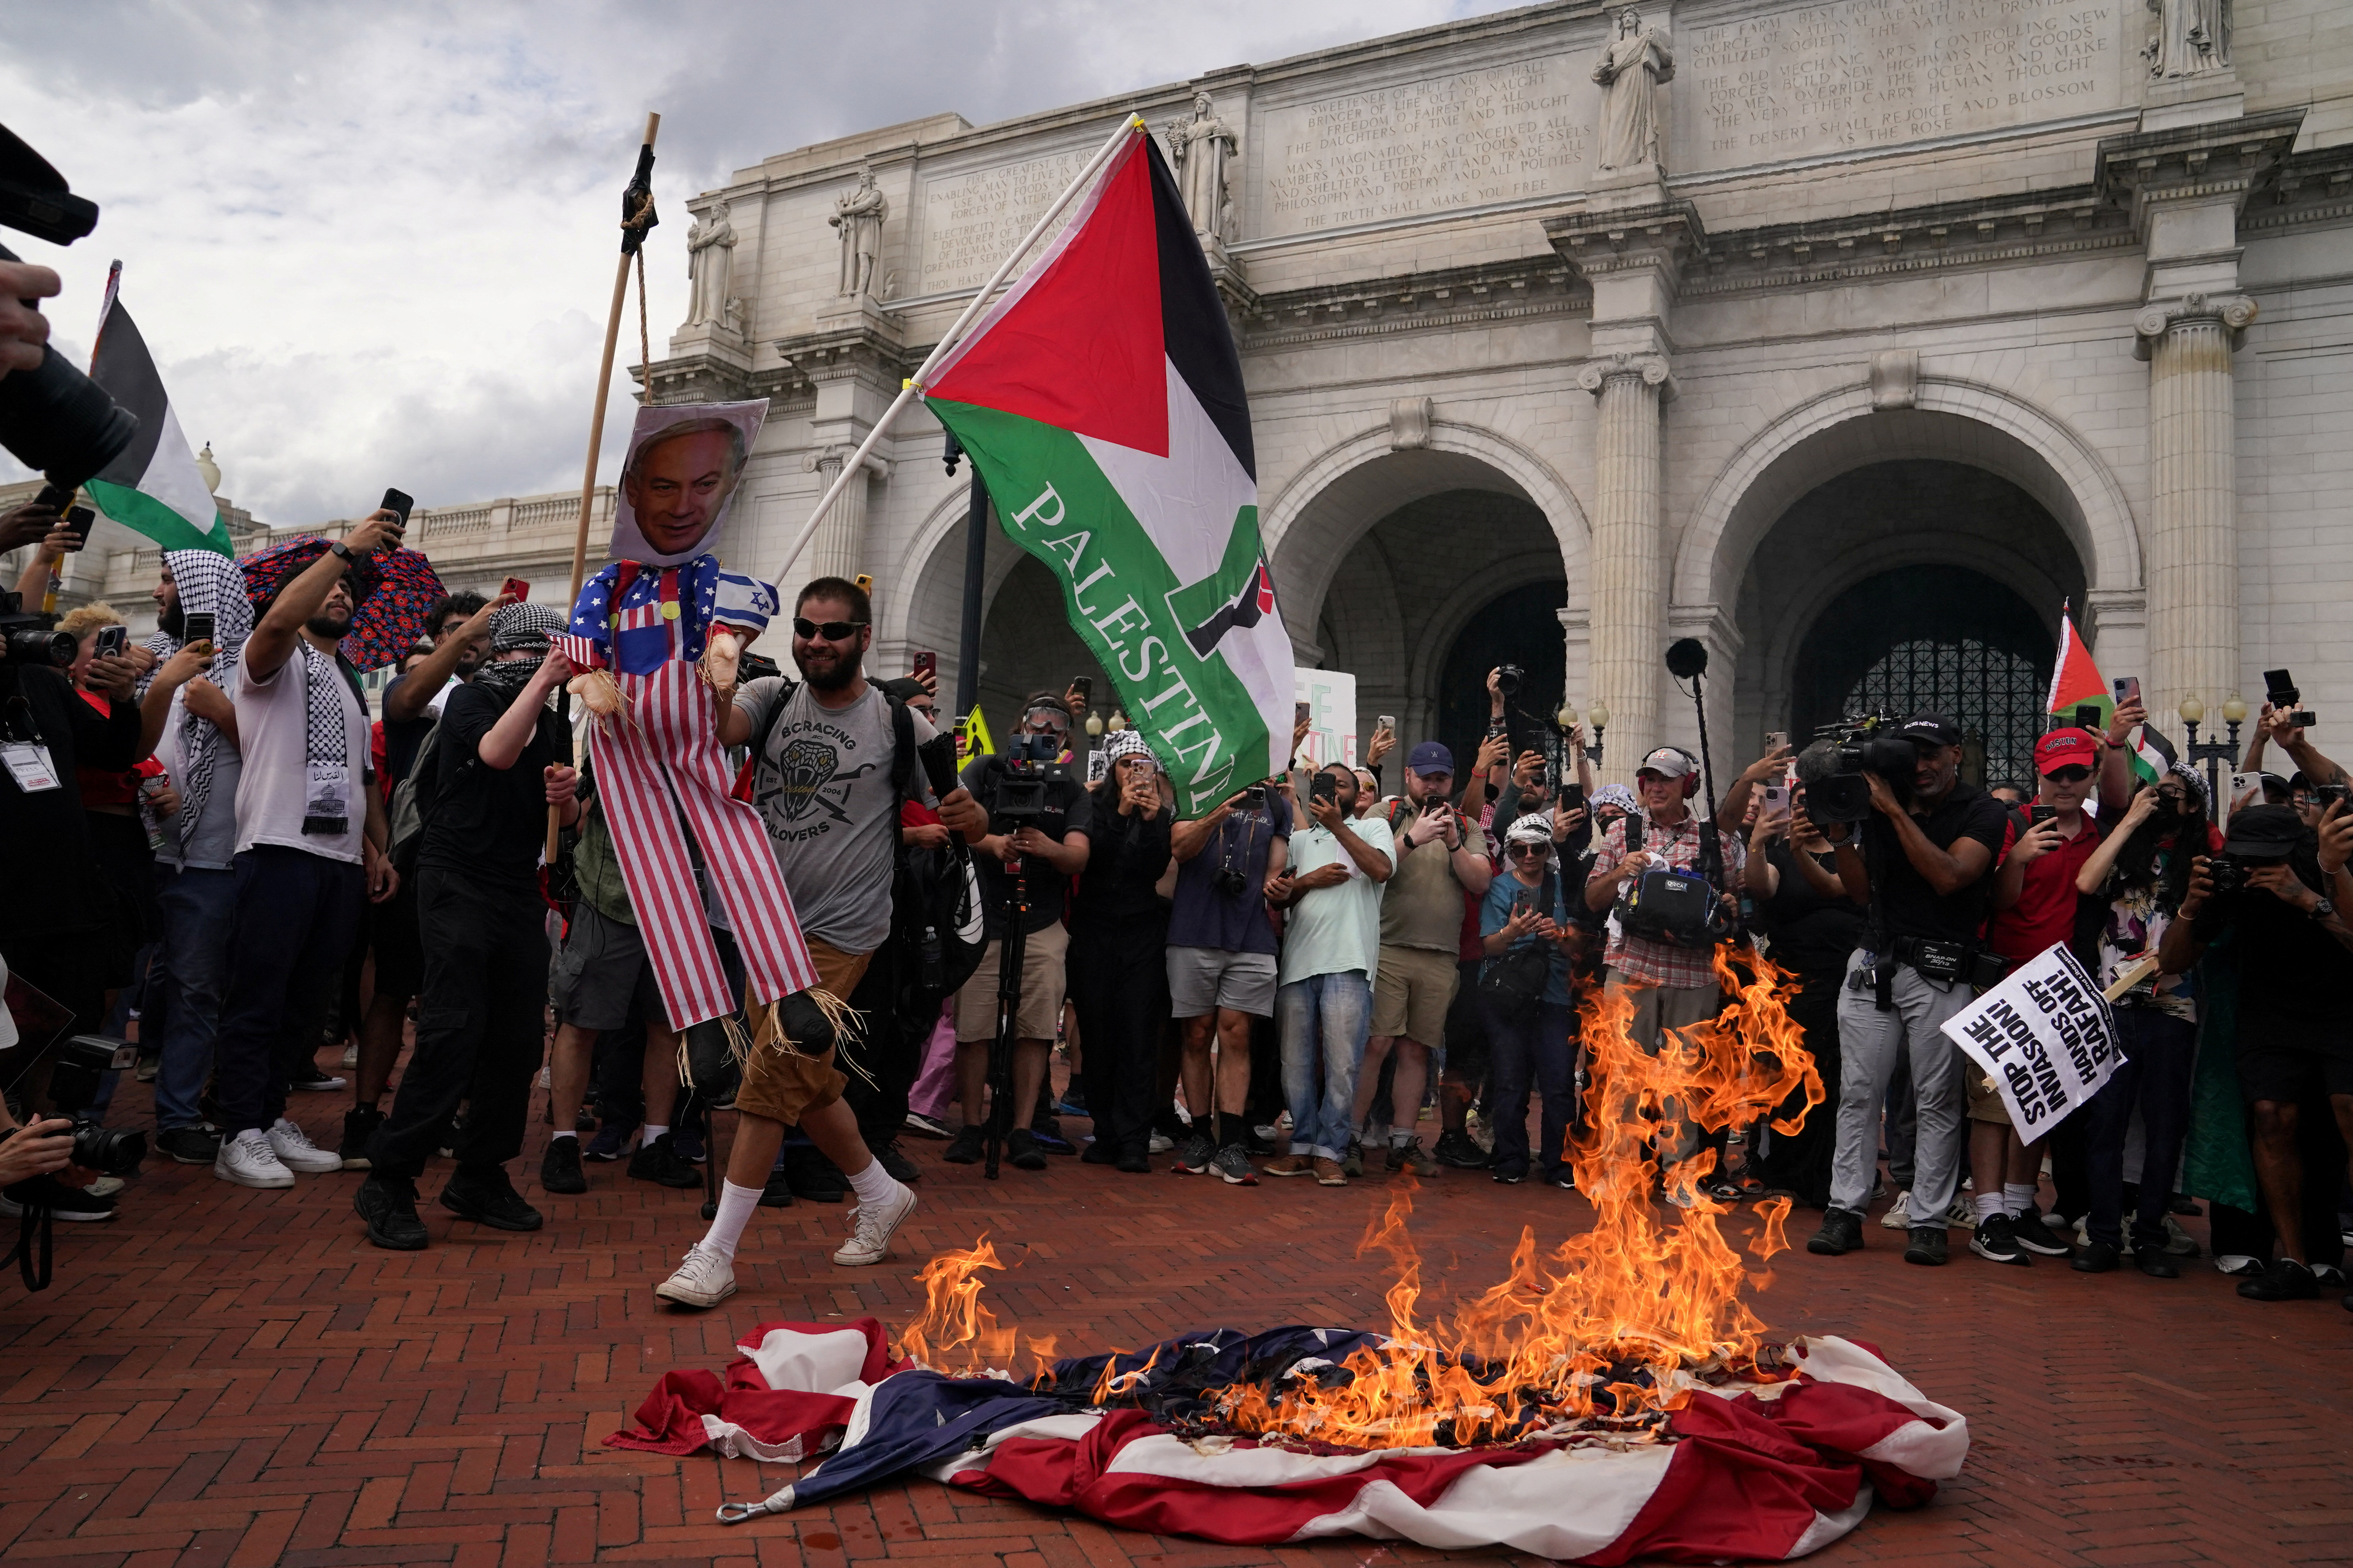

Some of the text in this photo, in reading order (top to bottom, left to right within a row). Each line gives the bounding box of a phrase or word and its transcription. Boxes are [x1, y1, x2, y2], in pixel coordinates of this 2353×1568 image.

[1693, 0, 1949, 57] SOURCE OF NATIONAL WEALTH
[1694, 6, 1990, 70] CIVILIZED SOCIETY THE NATURAL
[1701, 26, 1728, 42] THE
[1739, 17, 1780, 35] FARM
[1799, 6, 1836, 24] BEST
[1699, 7, 2110, 91] THE OLD MECHANIC ARTS CONTROLLING NEW
[1710, 25, 2092, 102] FORCES BUILD NEW HIGHWAYS FOR GOODS
[1308, 73, 1546, 128] BRINGER OF LIFE OUT OF NAUGHT
[1310, 61, 1546, 115] SWEETENER OF HUT AND OF HALL
[1701, 38, 2107, 117] AND MEN OVERRIDE THE OCEAN AND MAKE
[1712, 55, 2092, 129] THE VERY ETHER CARRY HUMAN THOUGHT
[1285, 94, 1569, 155] THE DAUGHTERS OF TIME AND THOUGHT
[1327, 89, 1524, 135] FREEDOM O FAIREST OF ALL
[1709, 79, 2094, 152] THE DESERT SHALL REJOICE AND BLOSSOM
[1834, 118, 1952, 146] AS THE ROSE
[1269, 124, 1590, 189] NUMBERS AND LETTERS ALL TOOLS VESSELS
[1287, 115, 1570, 175] MAN'S IMAGINATION HAS CONCEIVED ALL
[930, 165, 1070, 203] ENABLING MAN TO LIVE IN
[966, 173, 986, 185] FIRE
[998, 159, 1050, 178] GREATEST
[1056, 155, 1069, 166] OF
[1273, 138, 1584, 201] AND SHELTERS EVERY ART AND TRADE ALL
[1275, 151, 1581, 212] PHILOSOPHY AND POETRY AND ALL POLITIES
[951, 191, 1052, 219] FORCES OF NATURE
[954, 181, 1048, 208] USE MANY FOODS
[1304, 179, 1548, 227] THE TRUTH SHALL MAKE YOU FREE
[933, 221, 995, 241] ELECTRICITY
[939, 242, 993, 261] OF HUMAN
[942, 231, 994, 249] DEVOURER
[999, 228, 1012, 238] OF
[925, 256, 974, 274] GREATEST
[927, 278, 951, 291] THOU
[958, 273, 984, 285] HAST
[2045, 737, 2077, 752] BOSTON
[322, 770, 344, 780] القدس
[1925, 954, 1957, 962] SNAP-ON
[2058, 950, 2083, 980] Liberation
[2082, 979, 2092, 992] and
[2090, 990, 2109, 1020] Socialism
[2022, 980, 2097, 1086] HANDS OFF
[2044, 969, 2110, 1066] RAFAH!
[1962, 1015, 2046, 1125] STOP THE
[1986, 998, 2068, 1113] INVASION!
